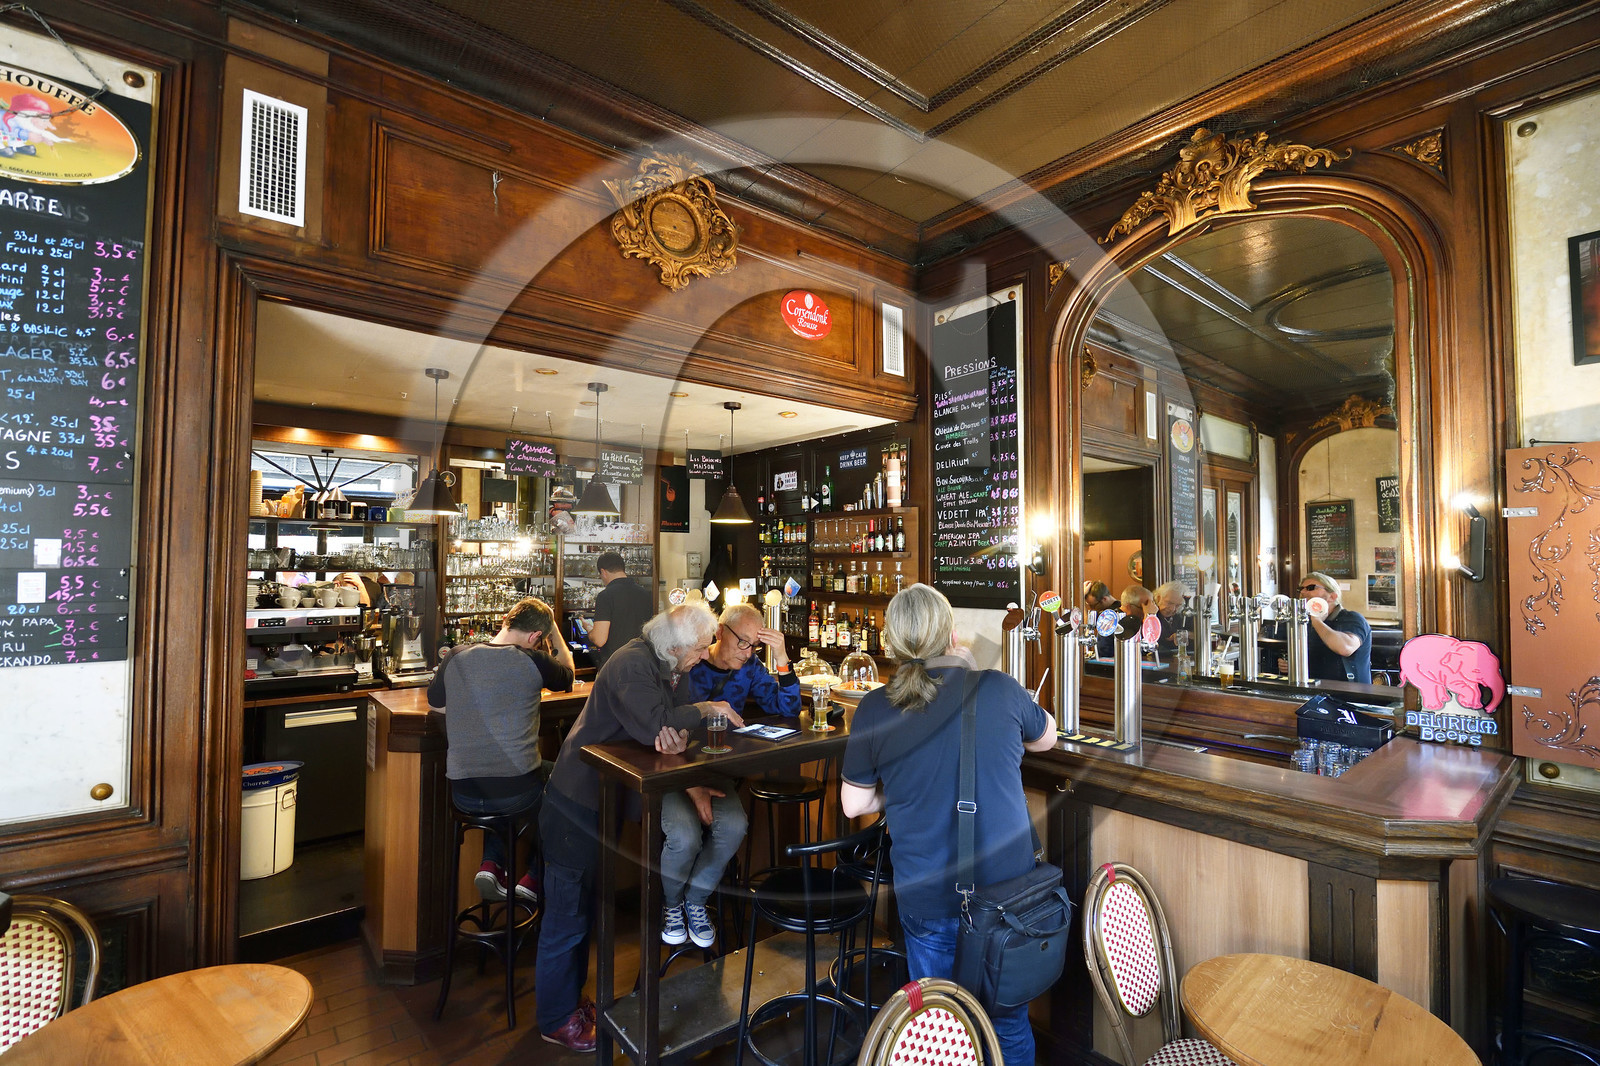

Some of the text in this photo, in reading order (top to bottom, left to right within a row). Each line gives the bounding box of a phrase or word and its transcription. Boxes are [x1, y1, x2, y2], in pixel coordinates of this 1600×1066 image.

[6, 242, 44, 256] Fruits
[0, 262, 27, 273] ard
[786, 299, 829, 325] Corsendonk
[797, 317, 818, 330] Rousse
[840, 458, 866, 468] DRINK BEER
[1406, 711, 1498, 735] DELIRIUM
[1421, 727, 1482, 746] Beers
